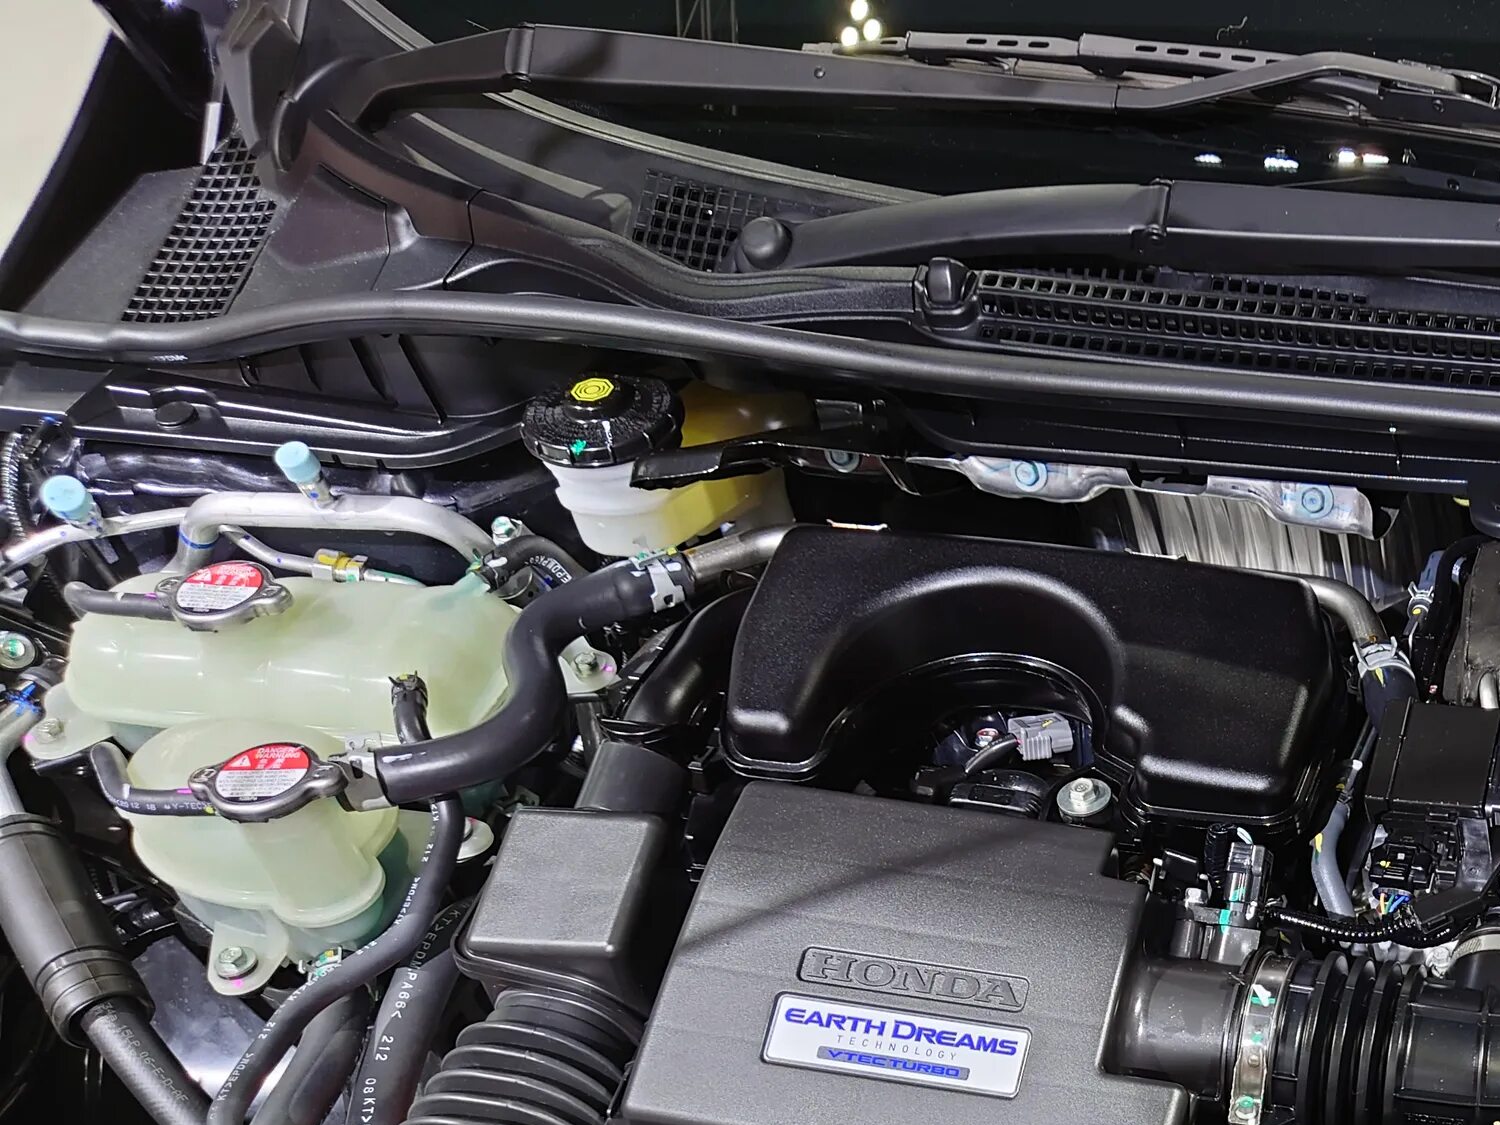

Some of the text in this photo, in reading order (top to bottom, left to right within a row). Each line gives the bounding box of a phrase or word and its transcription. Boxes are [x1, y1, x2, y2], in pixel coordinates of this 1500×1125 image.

[805, 953, 1022, 1008] HONDA
[257, 1020, 276, 1040] 212
[784, 1007, 1019, 1057] EARTH DREAMS
[374, 1035, 395, 1062] 212
[836, 1034, 959, 1062] TECHNOLOGY
[827, 1049, 961, 1078] VTEC TURBO
